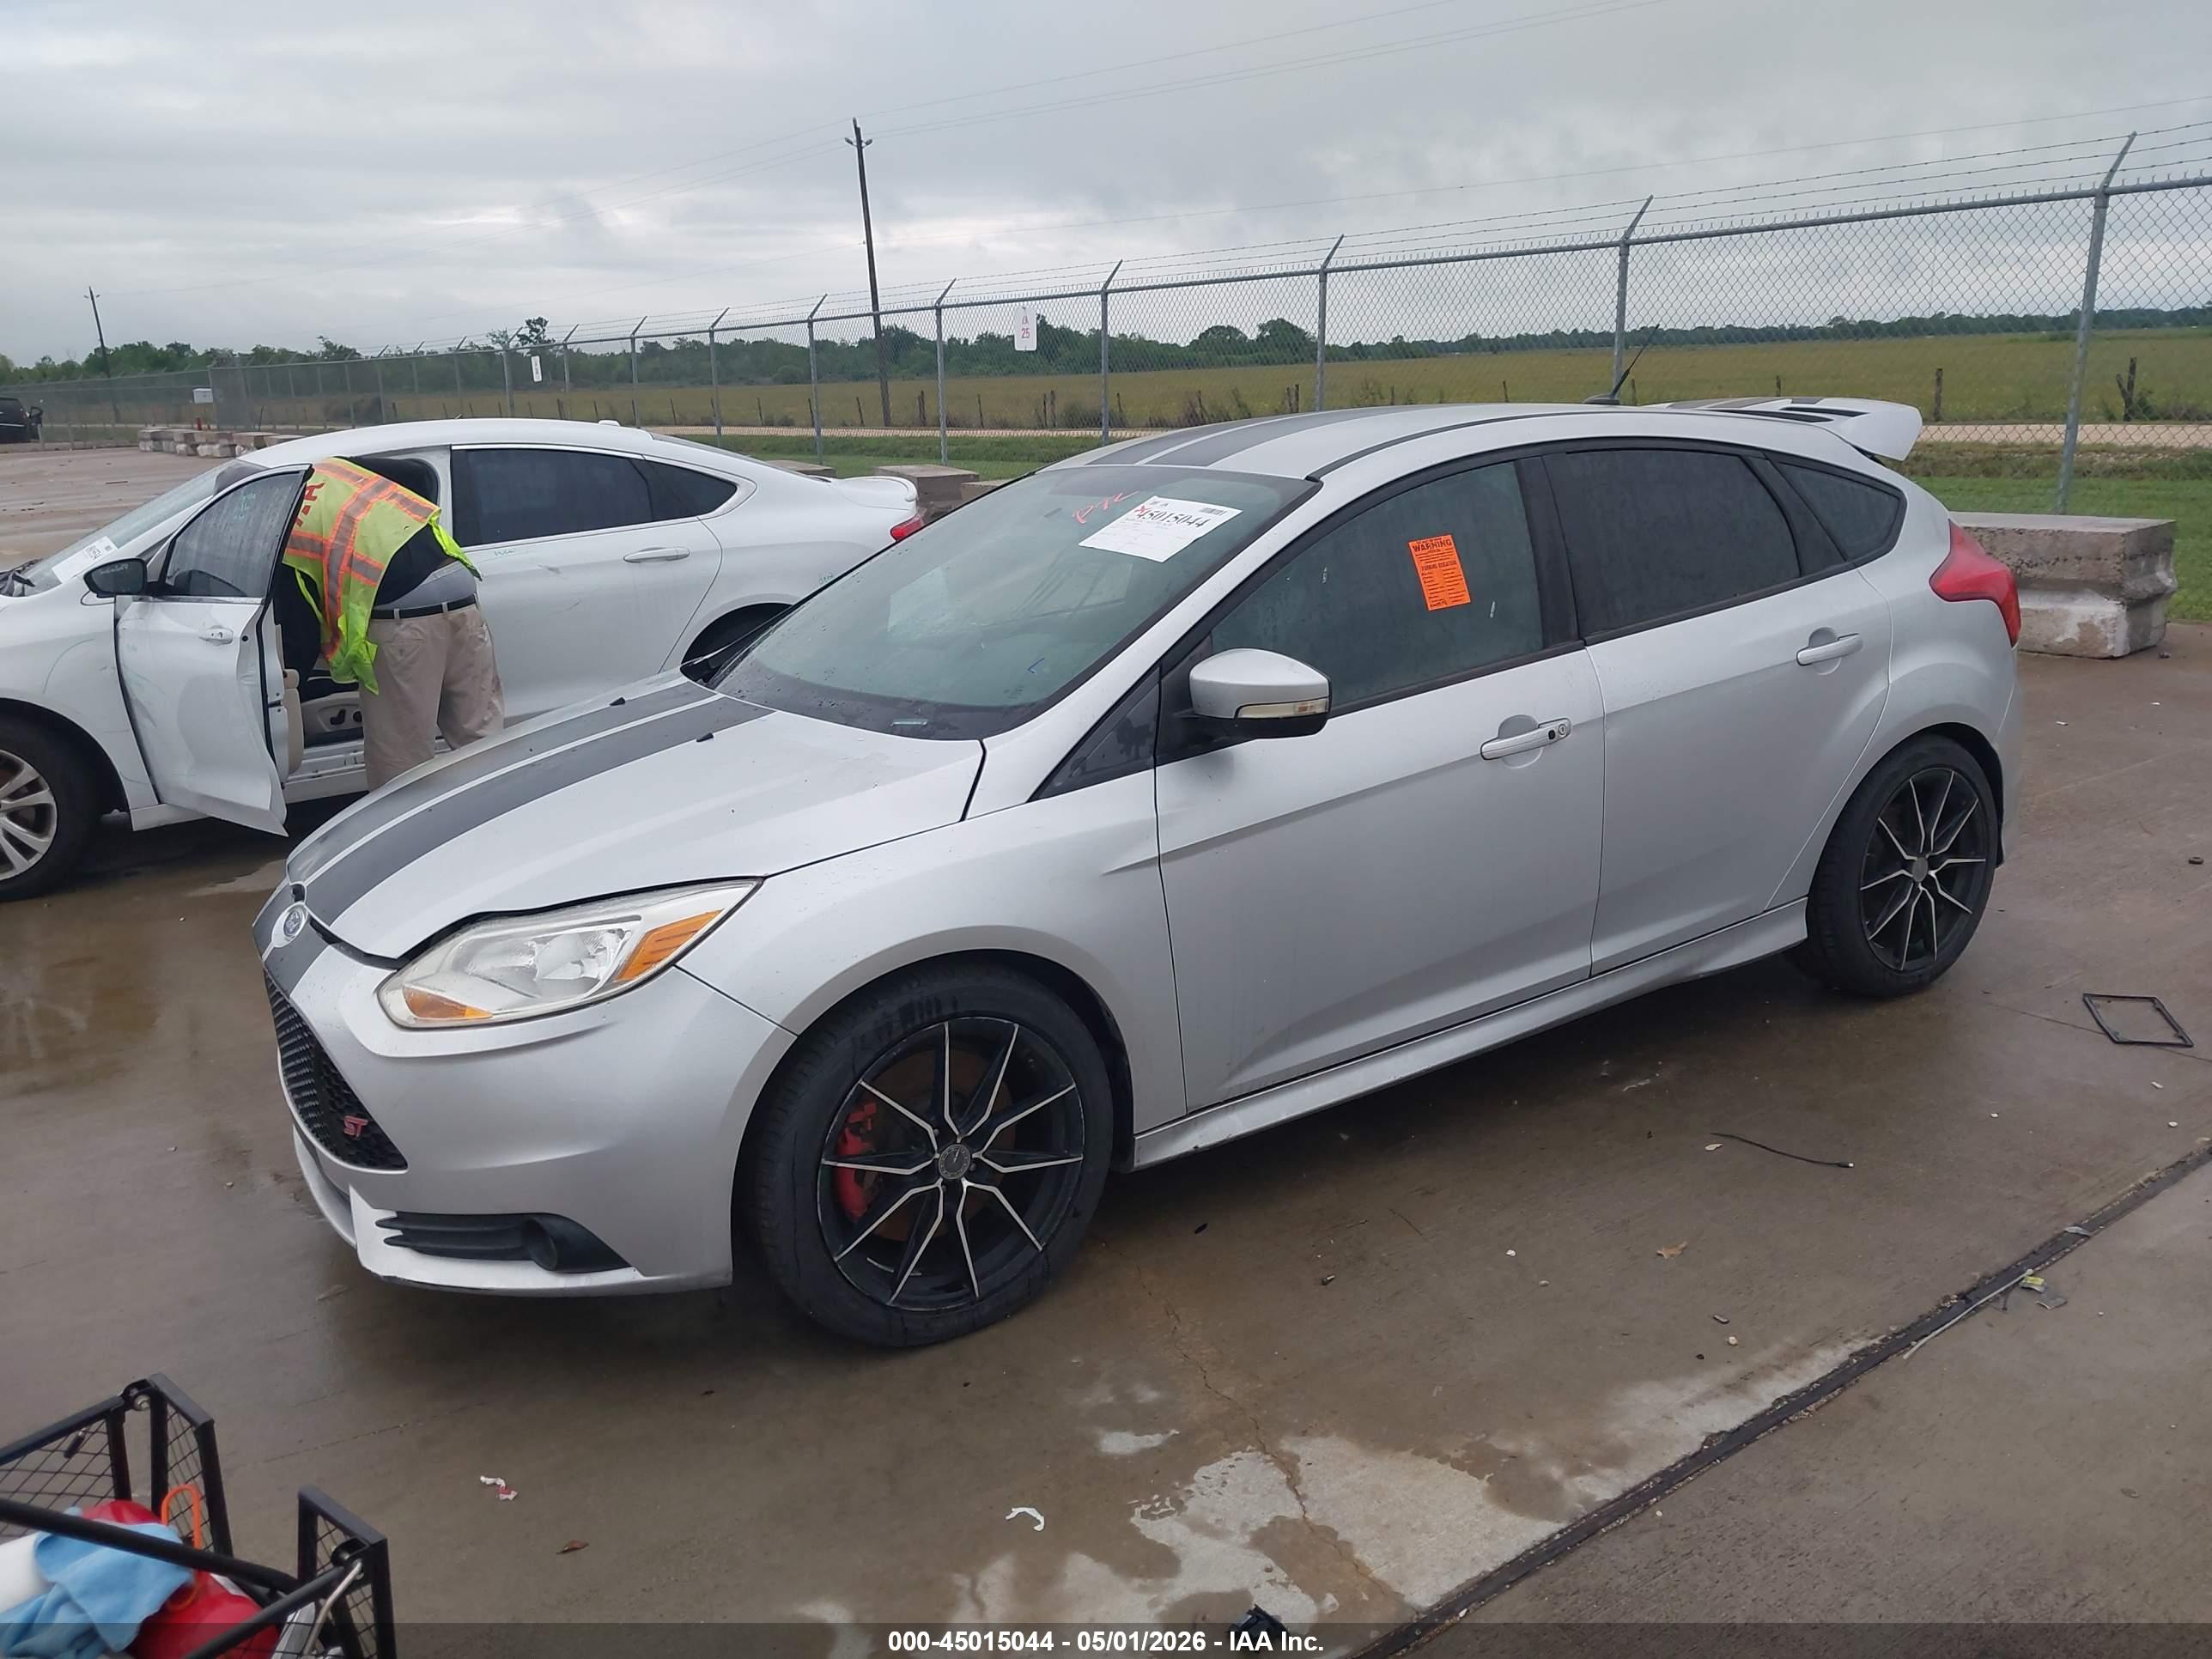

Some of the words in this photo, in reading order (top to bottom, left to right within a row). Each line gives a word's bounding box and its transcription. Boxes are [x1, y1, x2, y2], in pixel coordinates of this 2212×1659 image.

[1136, 509, 1211, 528] 45015044
[1412, 538, 1452, 552] WARNING
[343, 1115, 368, 1138] ST
